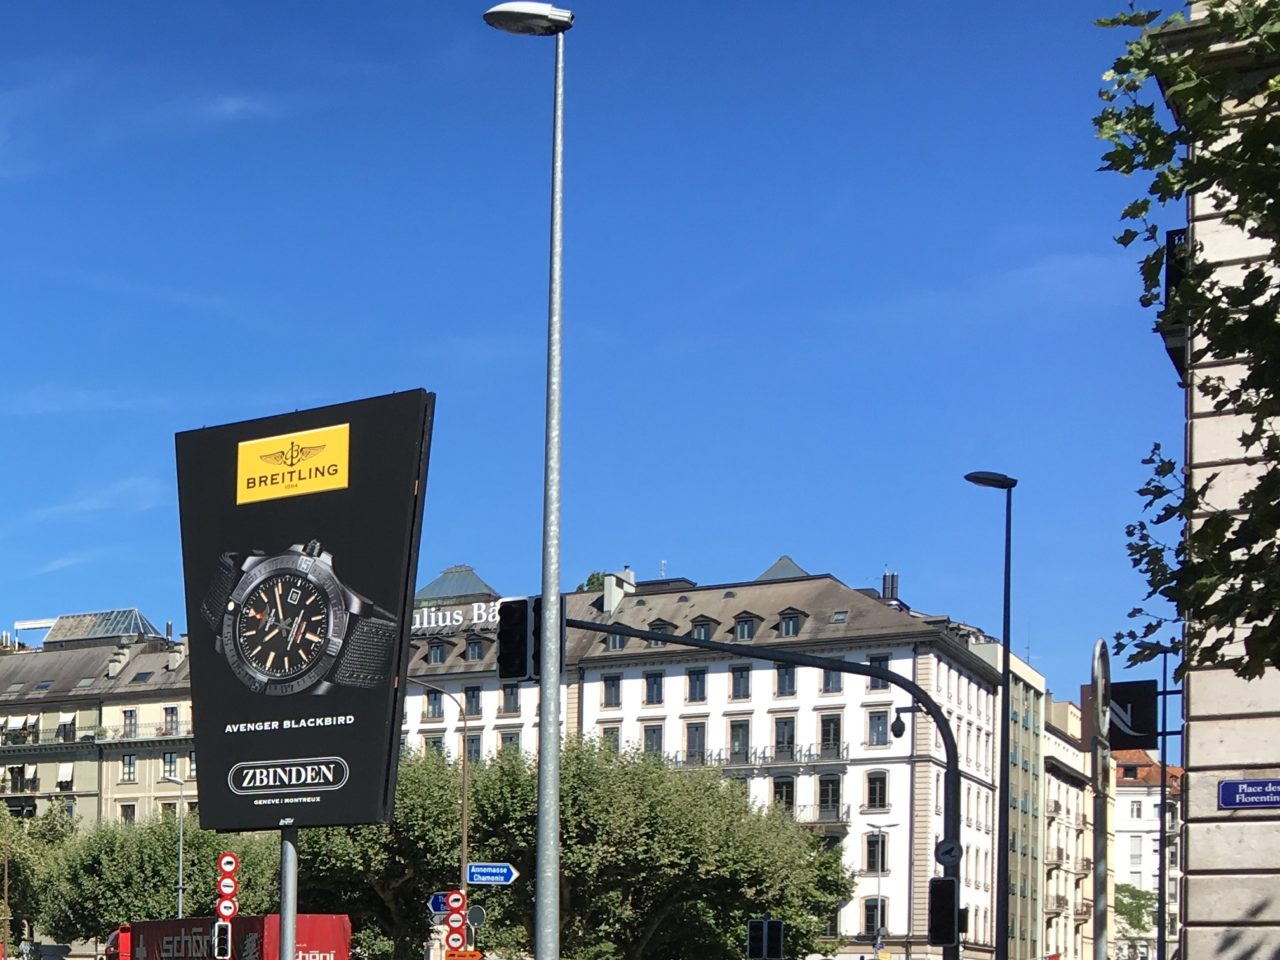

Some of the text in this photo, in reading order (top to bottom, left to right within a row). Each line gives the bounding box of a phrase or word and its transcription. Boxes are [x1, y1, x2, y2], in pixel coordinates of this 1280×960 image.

[247, 464, 338, 489] BREITLING
[411, 601, 500, 629] ulius Bä
[225, 715, 355, 733] AVENGER BLACKBIRD
[241, 764, 335, 787] ZBINDEN
[1238, 783, 1263, 793] Place
[253, 798, 280, 806] GENEVE
[284, 796, 321, 804] MONTREUX
[1235, 793, 1280, 803] Florentin
[471, 865, 508, 874] Annemasse
